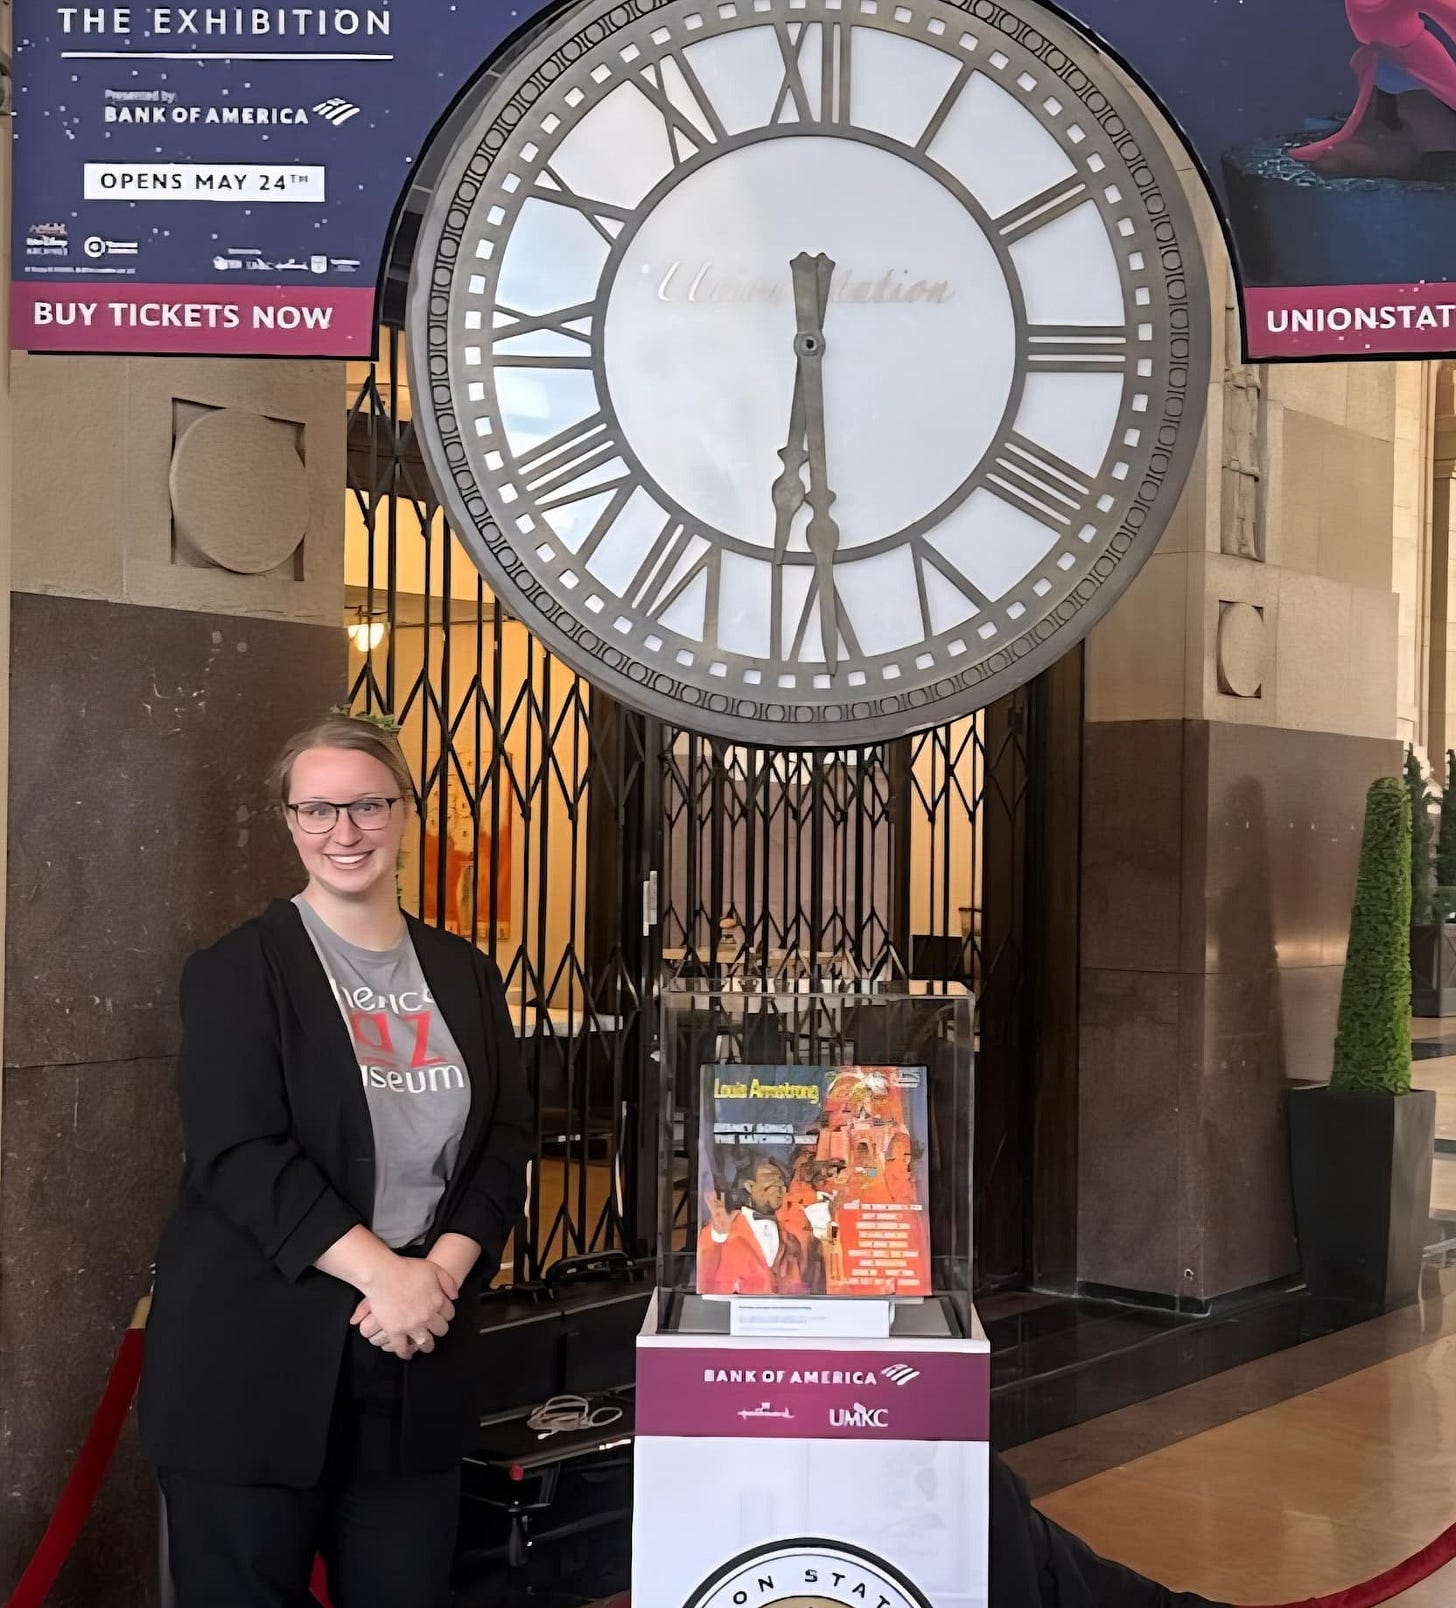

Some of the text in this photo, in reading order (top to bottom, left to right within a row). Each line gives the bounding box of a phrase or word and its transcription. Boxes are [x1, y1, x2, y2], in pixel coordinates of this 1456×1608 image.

[58, 8, 391, 35] THE EXHIBITION
[104, 106, 309, 125] BANK OF AMERICA
[100, 173, 182, 190] OPENS
[195, 174, 247, 190] MAY
[831, 266, 956, 304] tation
[34, 302, 333, 329] BUY TICKETS NOW
[1267, 304, 1456, 332] UNIONSTAT
[361, 1065, 464, 1093] seum
[714, 1078, 819, 1104] Louis Armstrong
[704, 1369, 877, 1384] BANK OF AMERICA
[829, 1402, 889, 1427] UMKC
